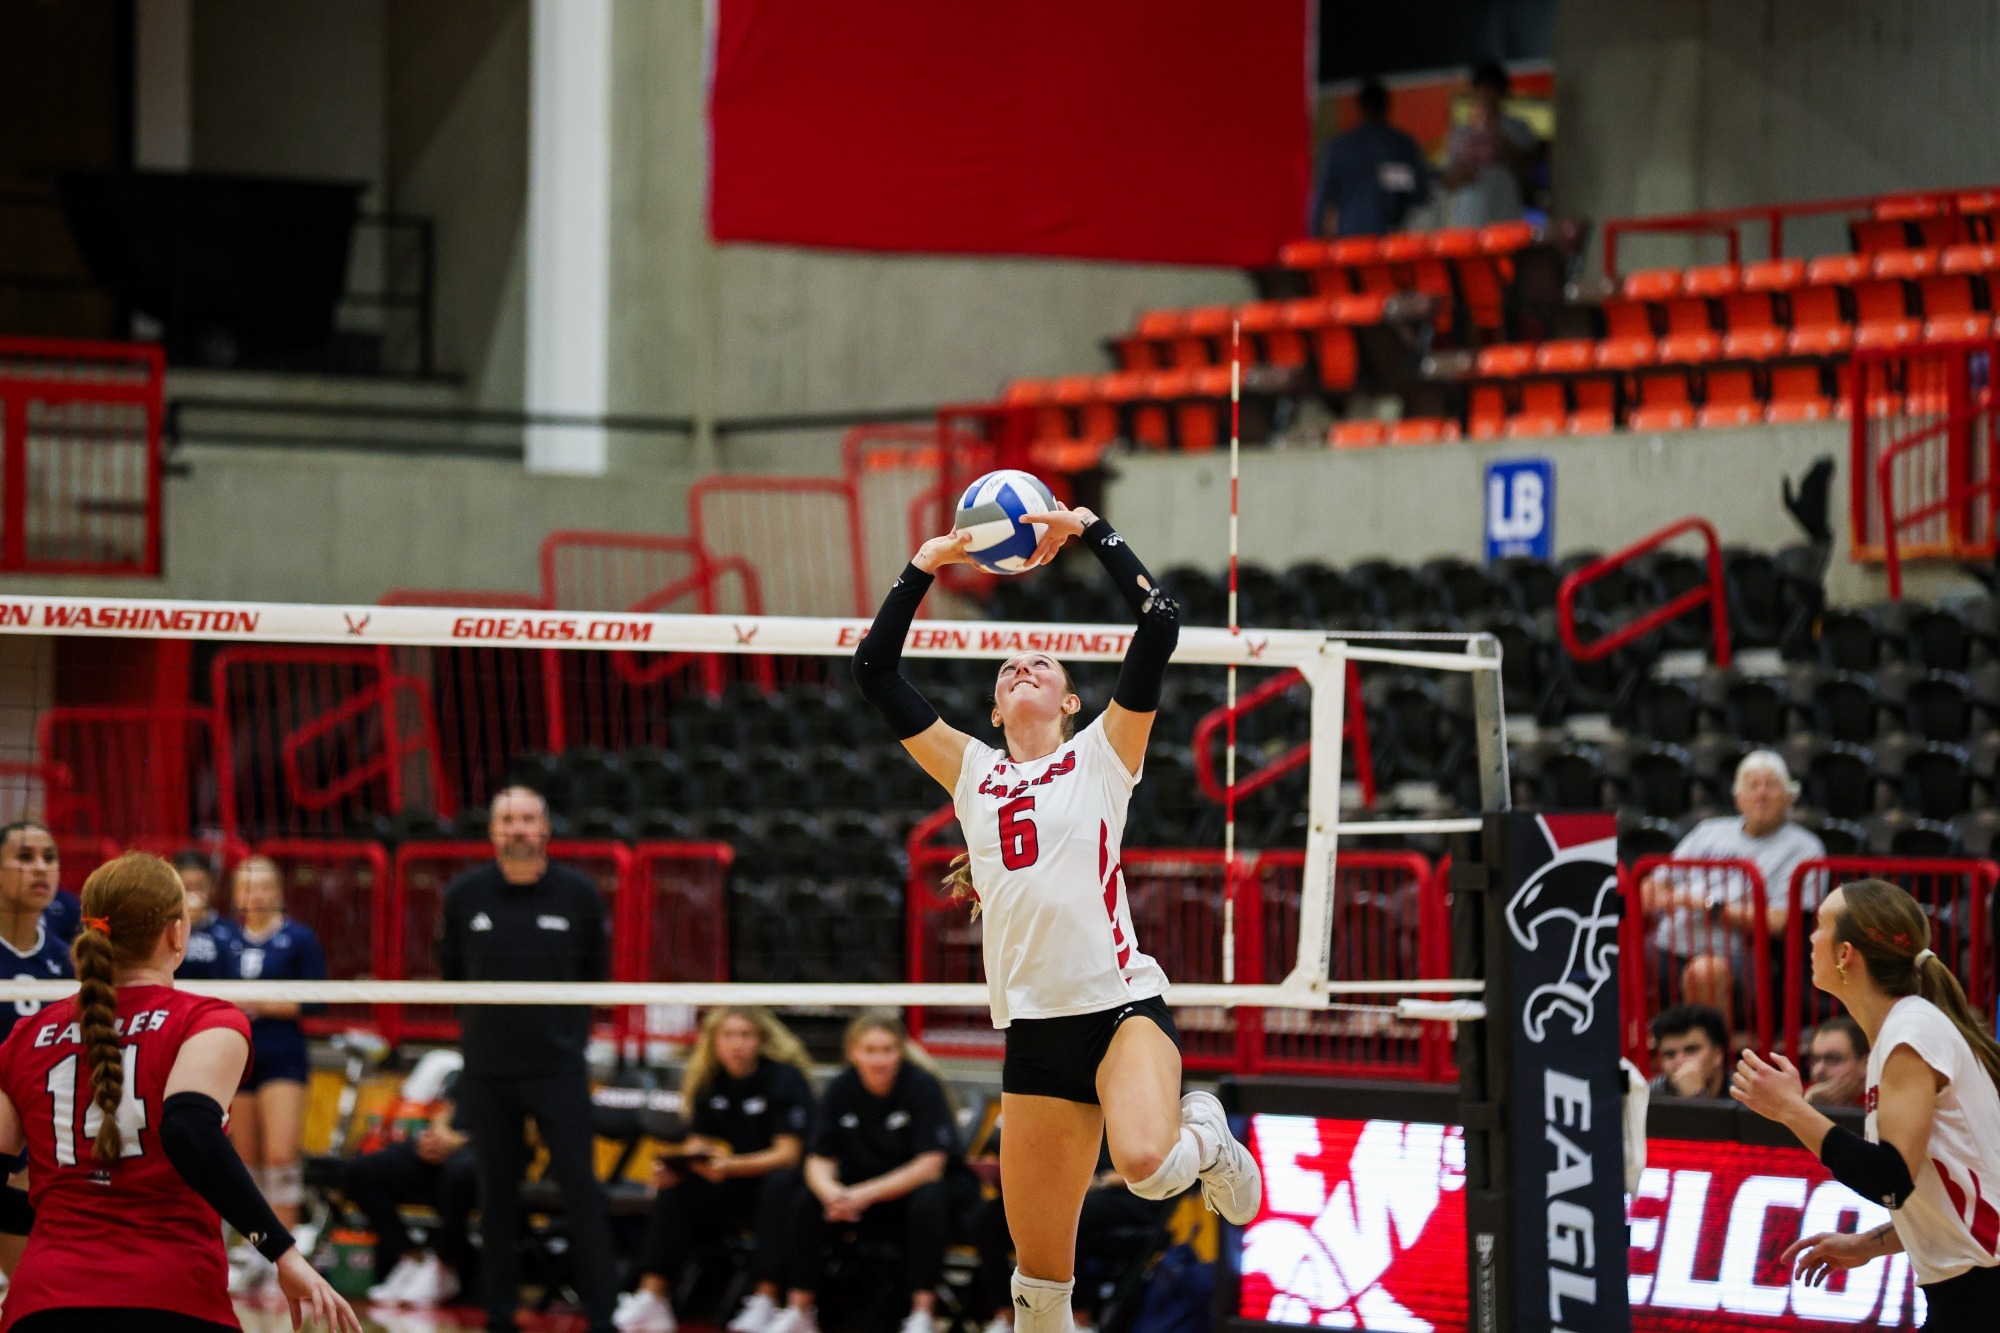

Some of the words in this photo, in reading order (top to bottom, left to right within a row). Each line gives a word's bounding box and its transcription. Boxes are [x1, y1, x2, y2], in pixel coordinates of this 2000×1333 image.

[1489, 470, 1544, 541] LB
[43, 605, 260, 633] WASHINGTON
[452, 617, 653, 642] GOEAGS.COM
[978, 629, 1136, 653] WASHINGT
[998, 796, 1039, 871] 6
[34, 1010, 170, 1049] EALES
[46, 1043, 148, 1169] 14
[1544, 1067, 1597, 1333] EAGL
